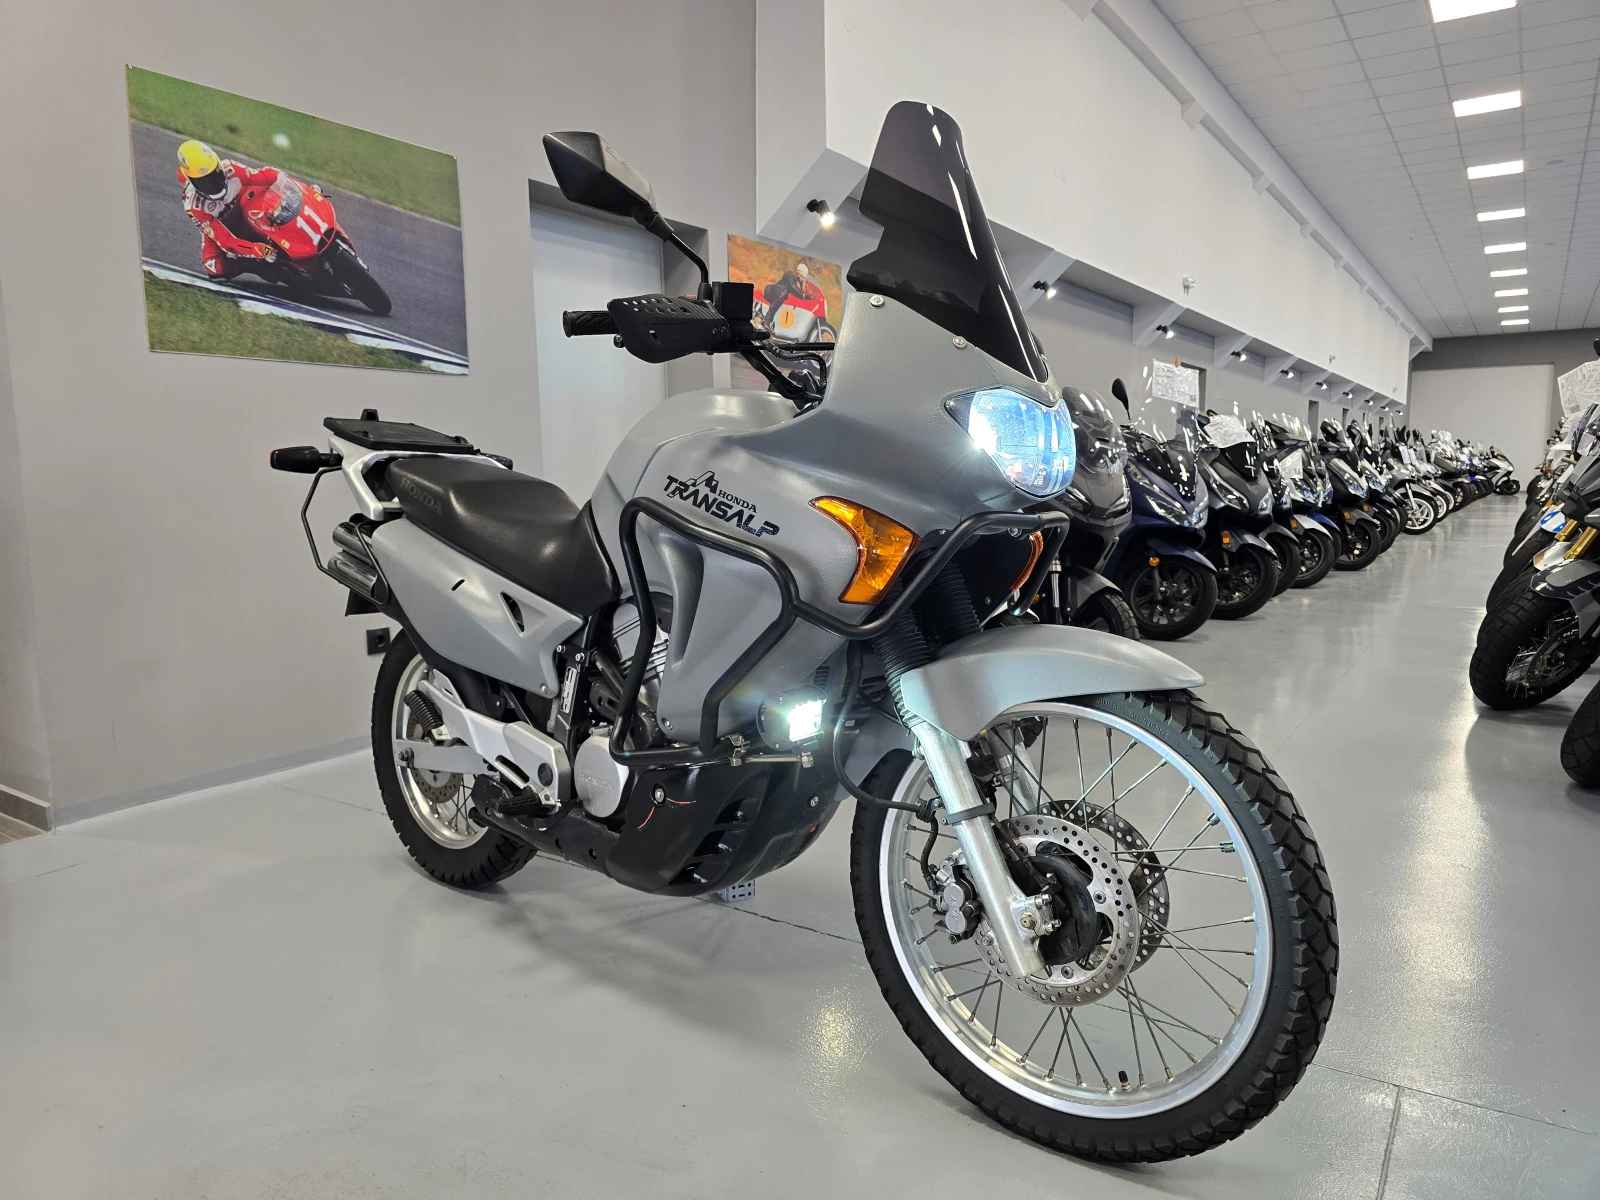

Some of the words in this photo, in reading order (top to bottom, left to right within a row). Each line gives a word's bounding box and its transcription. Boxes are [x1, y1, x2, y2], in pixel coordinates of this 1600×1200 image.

[296, 204, 329, 247] 11
[400, 476, 443, 515] HONDA
[663, 474, 780, 538] TRANSALP
[717, 489, 758, 514] HONDA
